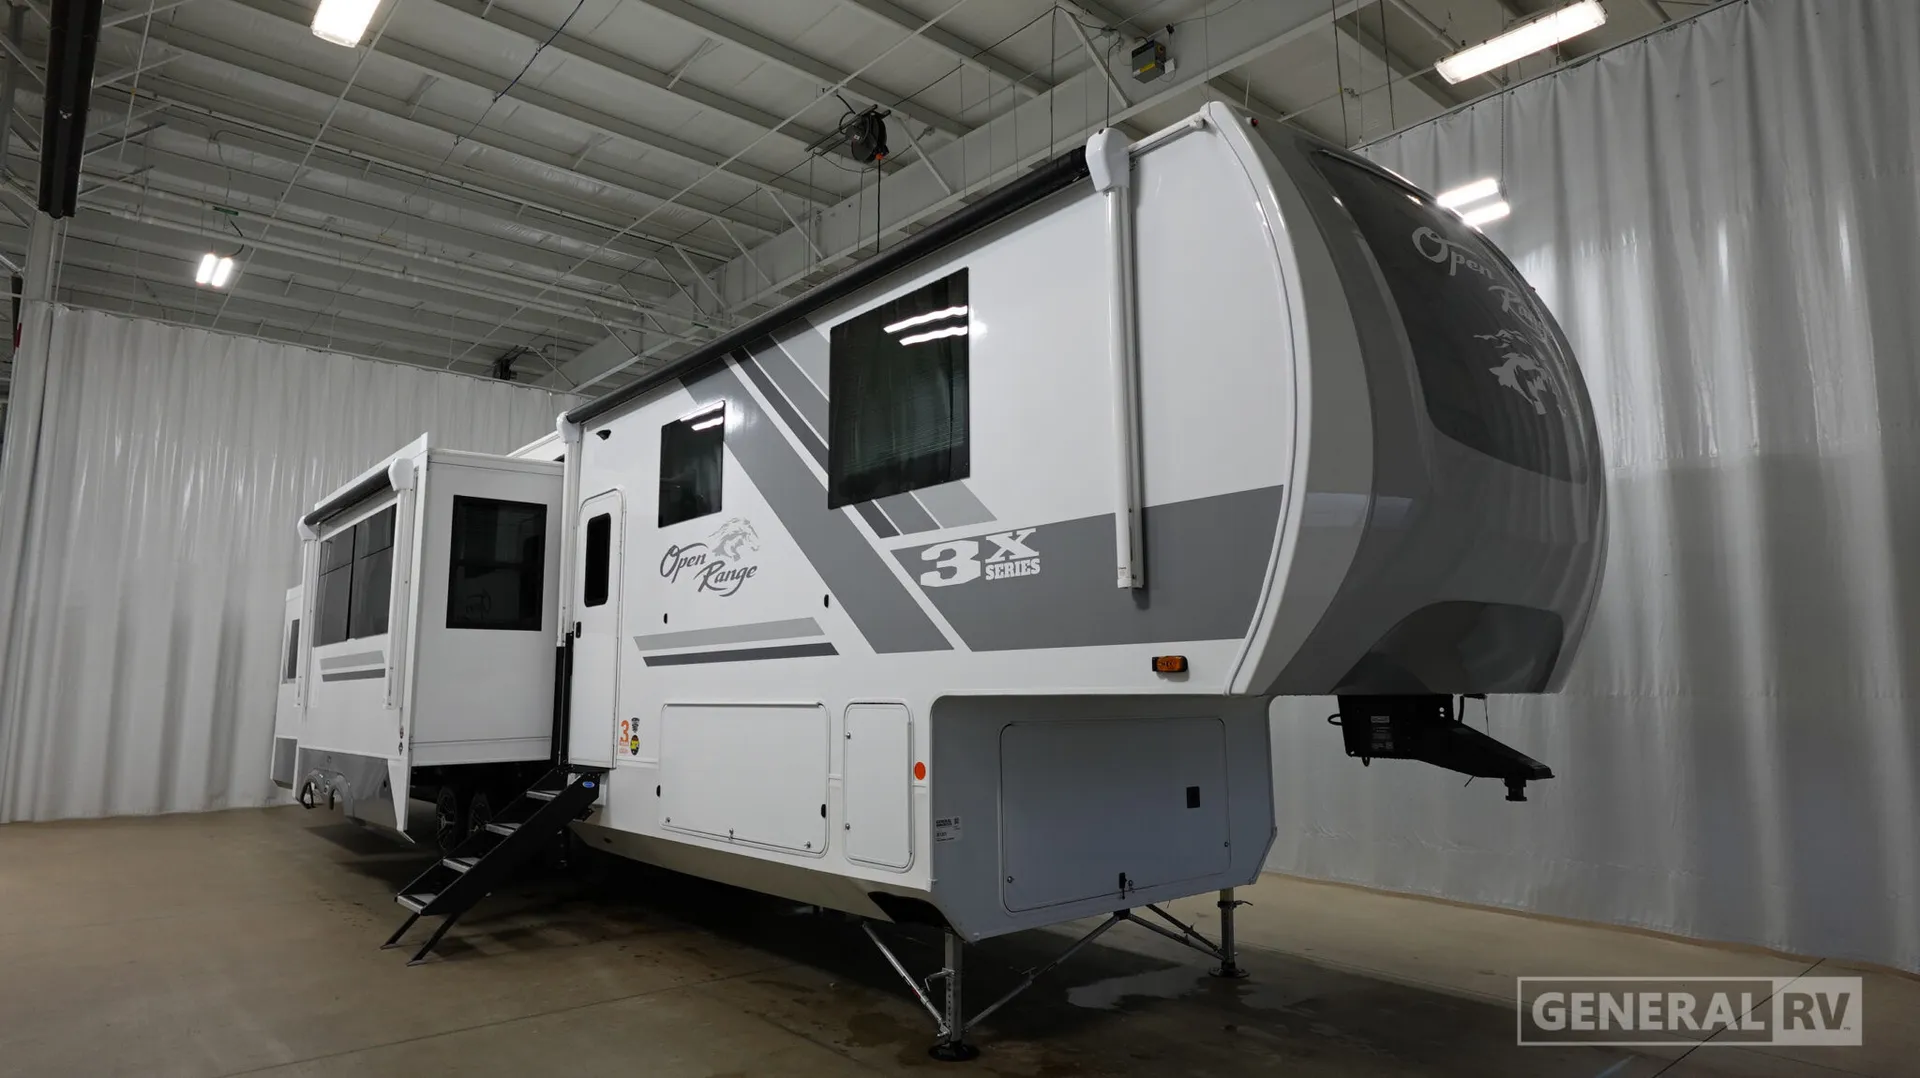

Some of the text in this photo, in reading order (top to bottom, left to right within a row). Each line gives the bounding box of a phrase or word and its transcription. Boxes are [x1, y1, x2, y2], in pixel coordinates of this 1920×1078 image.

[1412, 226, 1495, 279] Open
[660, 542, 709, 584] Open
[693, 560, 758, 597] Range
[985, 558, 1040, 580] SERIES
